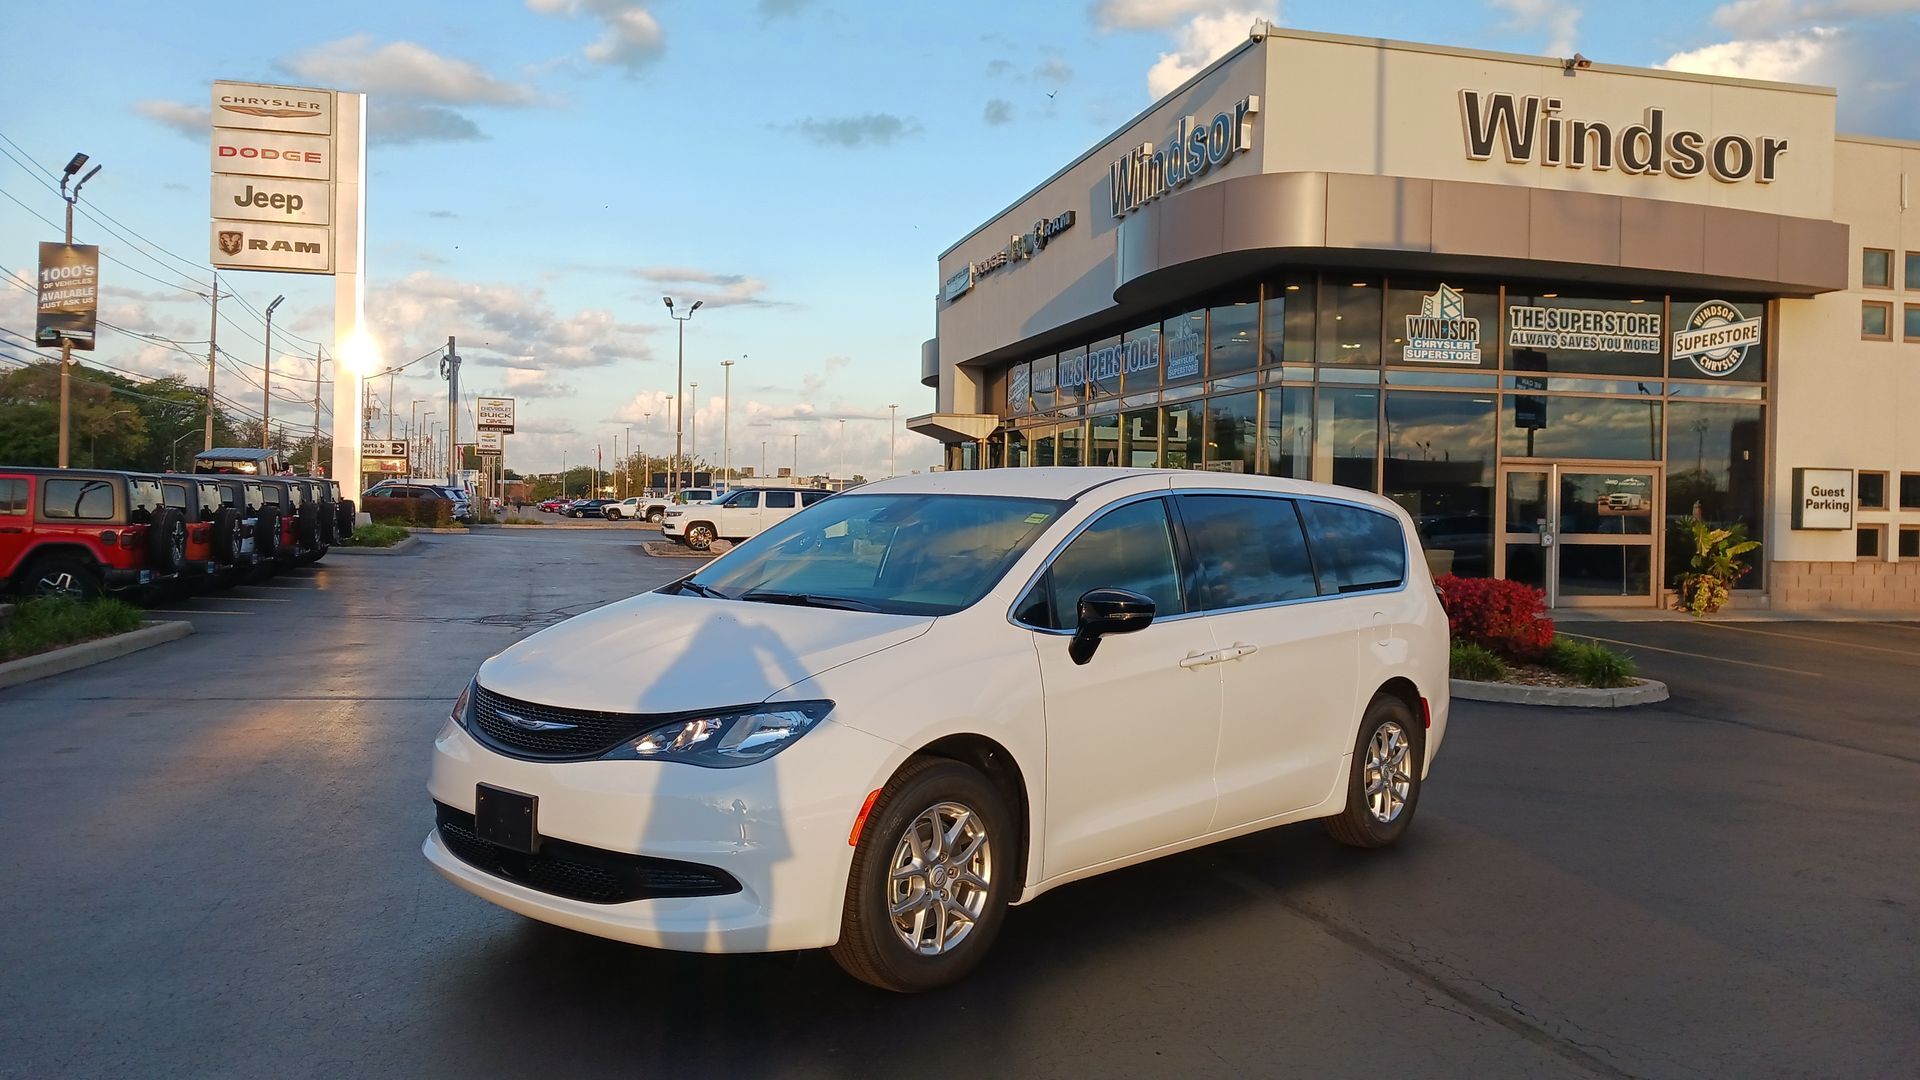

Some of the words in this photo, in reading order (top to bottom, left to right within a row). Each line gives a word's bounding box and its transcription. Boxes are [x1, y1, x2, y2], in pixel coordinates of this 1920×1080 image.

[221, 96, 321, 110] CHRYSLER
[1459, 89, 1788, 183] Windsor
[219, 146, 322, 163] DODGE
[1109, 95, 1260, 218] Windsor
[234, 185, 303, 214] Jeep
[1044, 211, 1075, 237] RAM
[248, 239, 321, 254] RAM
[56, 279, 93, 287] VEHICLES
[41, 287, 94, 301] AVAILABLE
[41, 301, 61, 309] JUST
[1512, 308, 1544, 328] THE
[1547, 310, 1659, 335] SUPERSTORE
[1692, 306, 1735, 327] WINDSOR
[1408, 318, 1477, 341] WINDSOR
[1677, 325, 1758, 352] SUPERSTORE
[1414, 340, 1471, 350] CHRYSLER
[1511, 332, 1558, 346] ALWAYS
[1560, 335, 1597, 348] SAVES
[1600, 338, 1621, 350] YOU
[1624, 338, 1659, 352] MORE!
[1074, 334, 1159, 386] SUPERSTORE
[1407, 349, 1478, 360] SUPERSTORE
[1700, 349, 1741, 371] CHRYSLER
[1811, 485, 1845, 498] Guest
[1805, 498, 1850, 513] Parking
